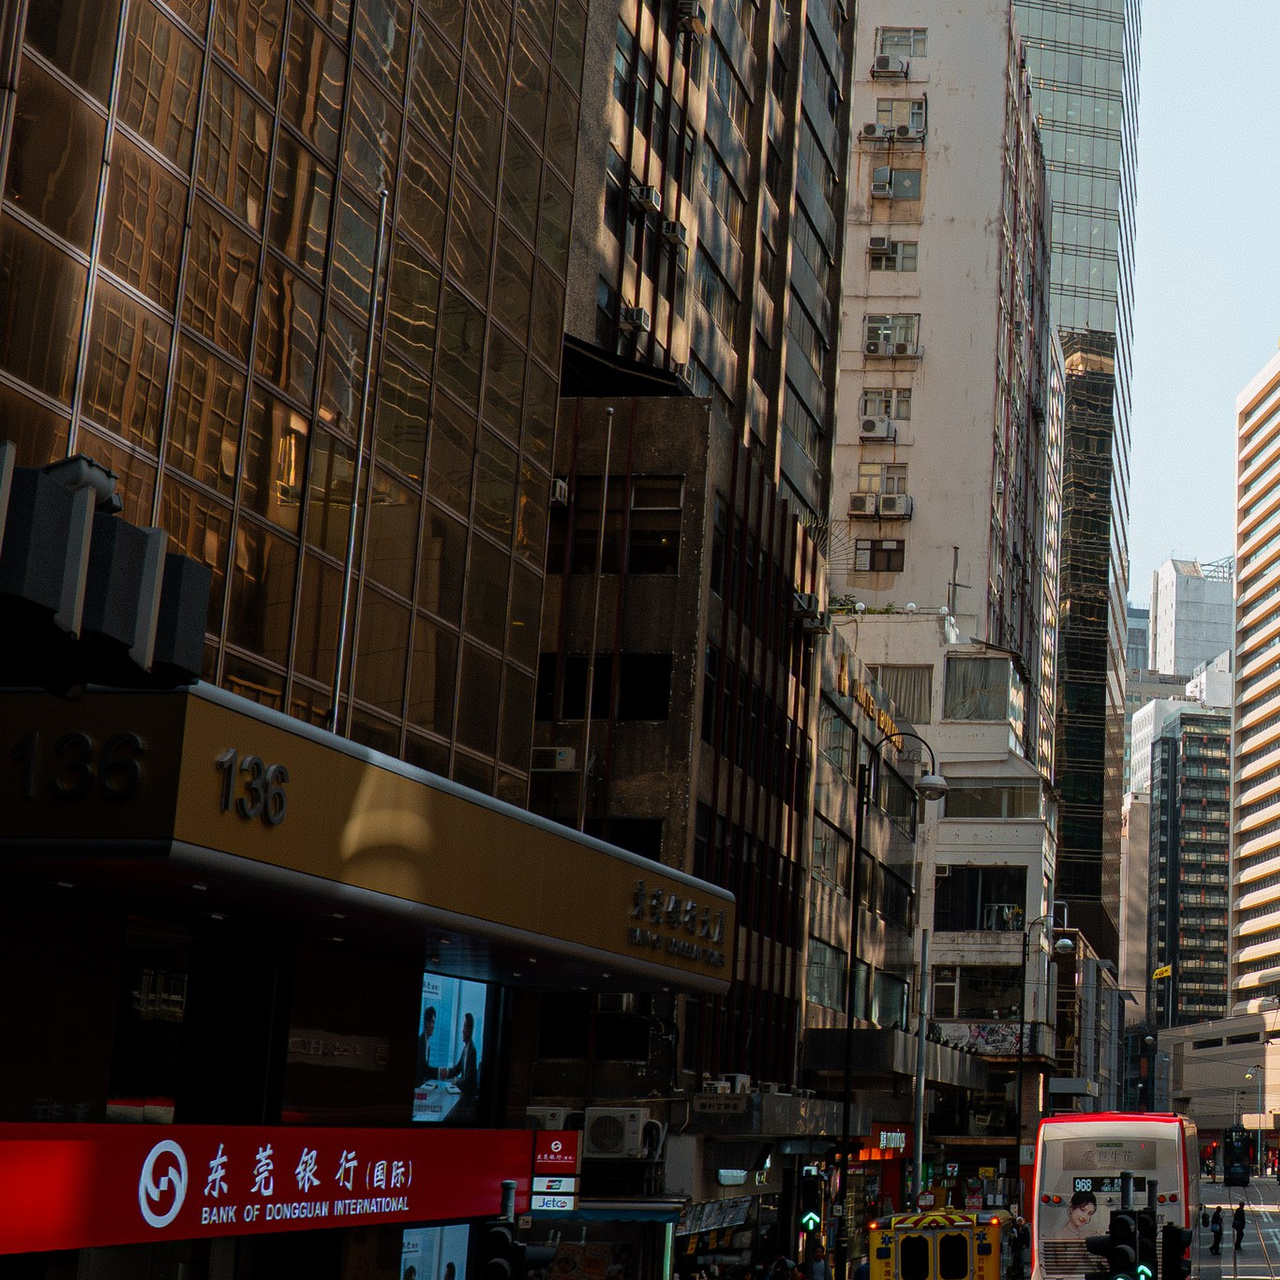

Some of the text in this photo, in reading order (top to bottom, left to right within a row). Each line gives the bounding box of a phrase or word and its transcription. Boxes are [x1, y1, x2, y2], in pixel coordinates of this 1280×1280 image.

[10, 730, 144, 802] 136
[216, 748, 289, 827] 136
[1074, 1178, 1093, 1192] 968
[201, 1196, 410, 1226] BANK OF DONGGUAN INTERNATIONAL
